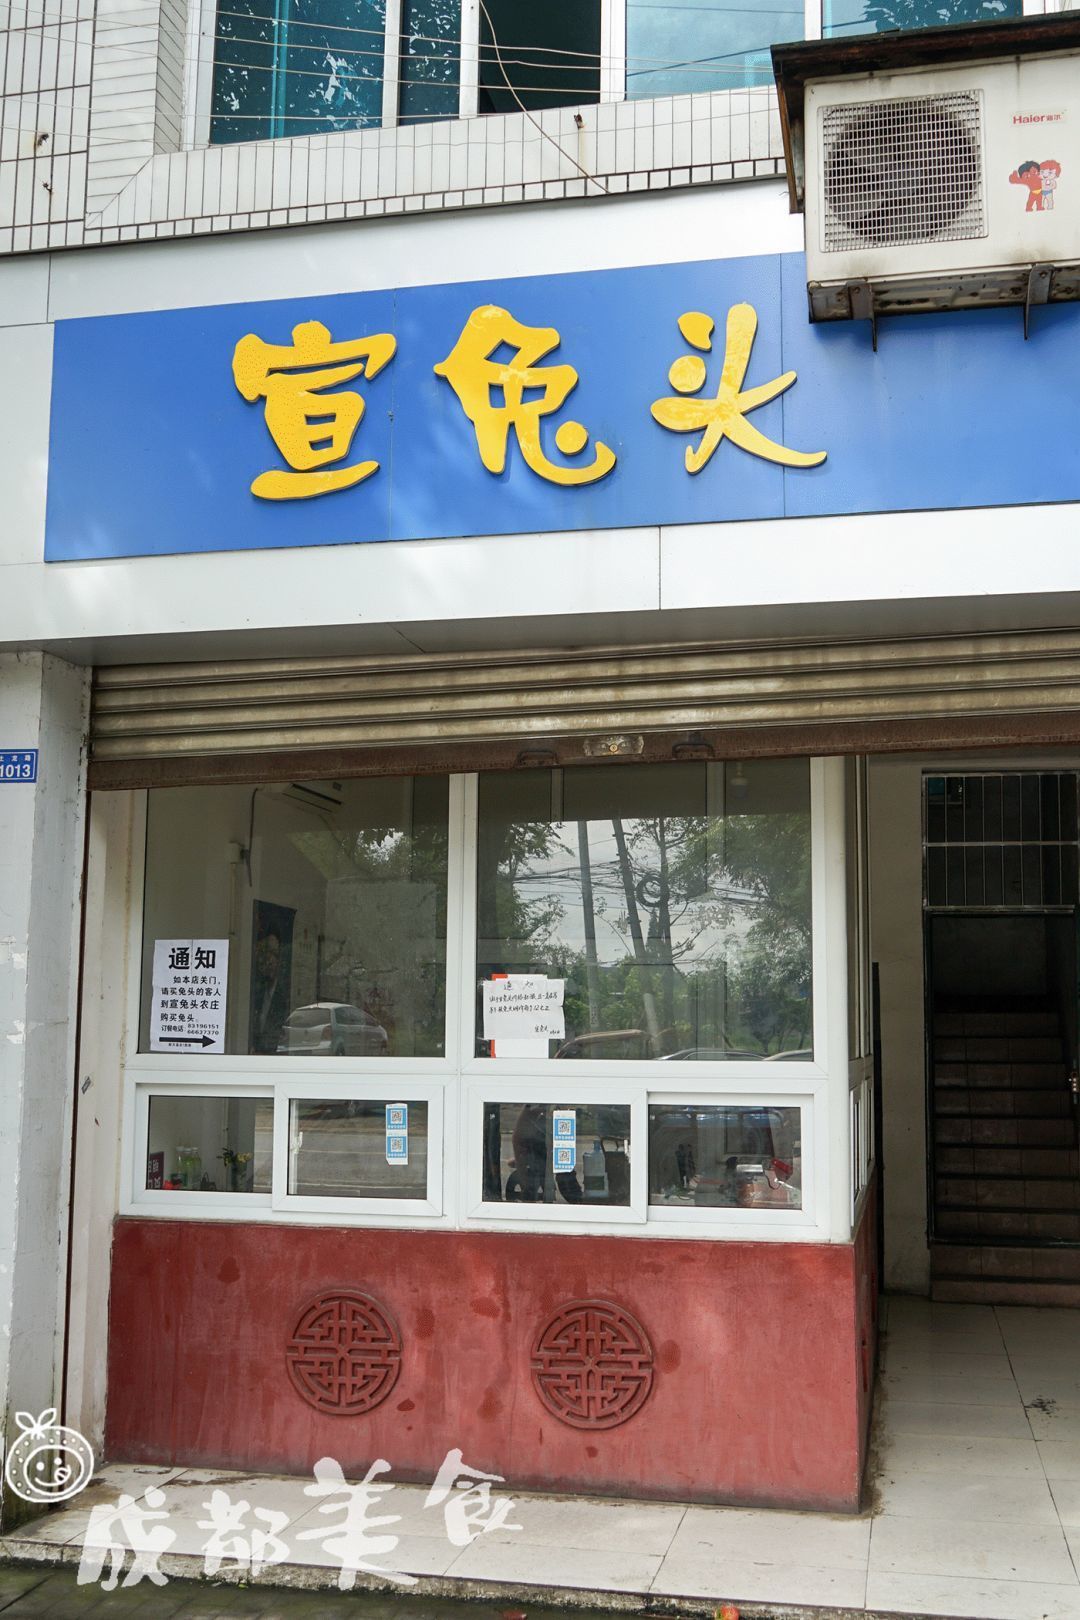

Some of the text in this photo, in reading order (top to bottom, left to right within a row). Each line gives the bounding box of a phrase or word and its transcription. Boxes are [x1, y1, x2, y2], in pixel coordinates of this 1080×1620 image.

[1013, 115, 1045, 124] Haier
[231, 302, 828, 502] 宣兔头
[0, 764, 31, 778] 1013
[168, 946, 216, 970] 通知
[161, 987, 221, 996] 请买兔头的客人
[160, 999, 220, 1010] 到宣兔头农庄
